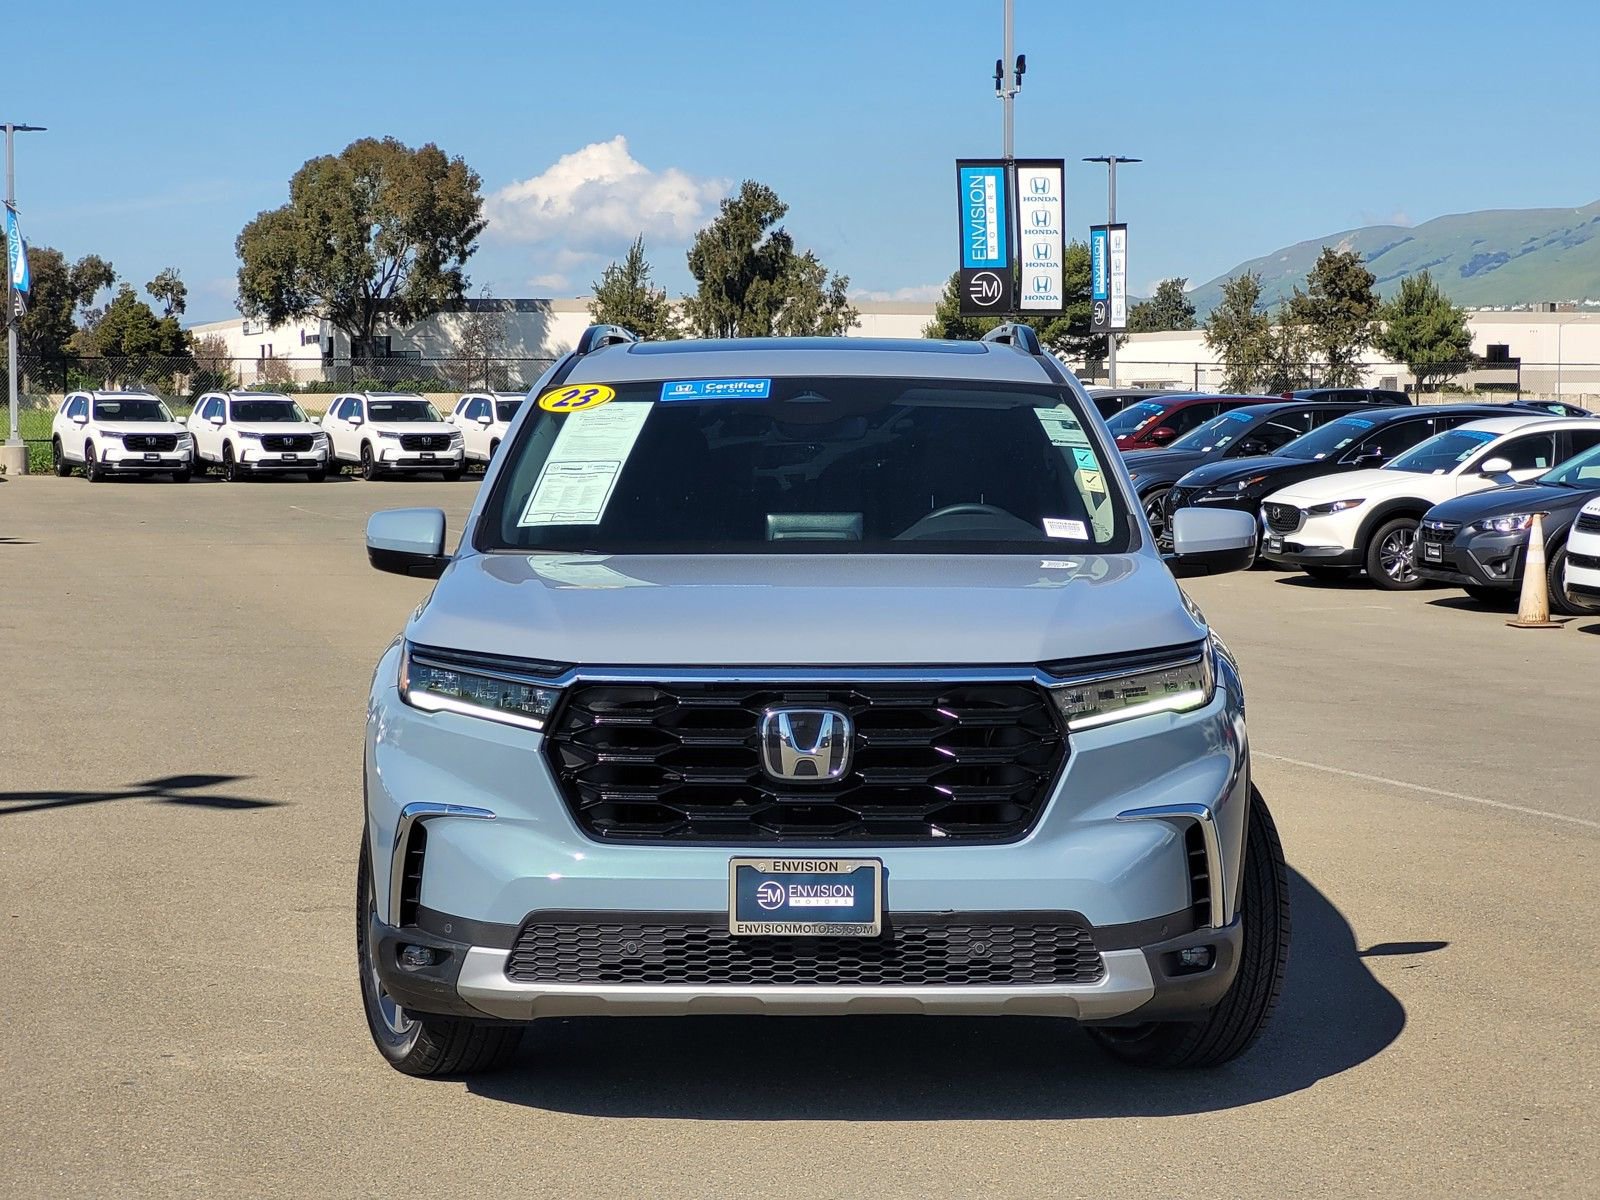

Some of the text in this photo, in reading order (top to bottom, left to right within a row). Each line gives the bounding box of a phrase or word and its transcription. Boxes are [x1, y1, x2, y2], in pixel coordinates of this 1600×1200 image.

[969, 175, 987, 261] ENVISION
[987, 183, 996, 253] MOTORS
[705, 382, 764, 390] Certified
[553, 388, 600, 408] 23
[773, 861, 838, 872] ENVISION
[789, 884, 854, 897] ENVISION
[737, 924, 873, 934] ENVISIONMOTORS.COM
